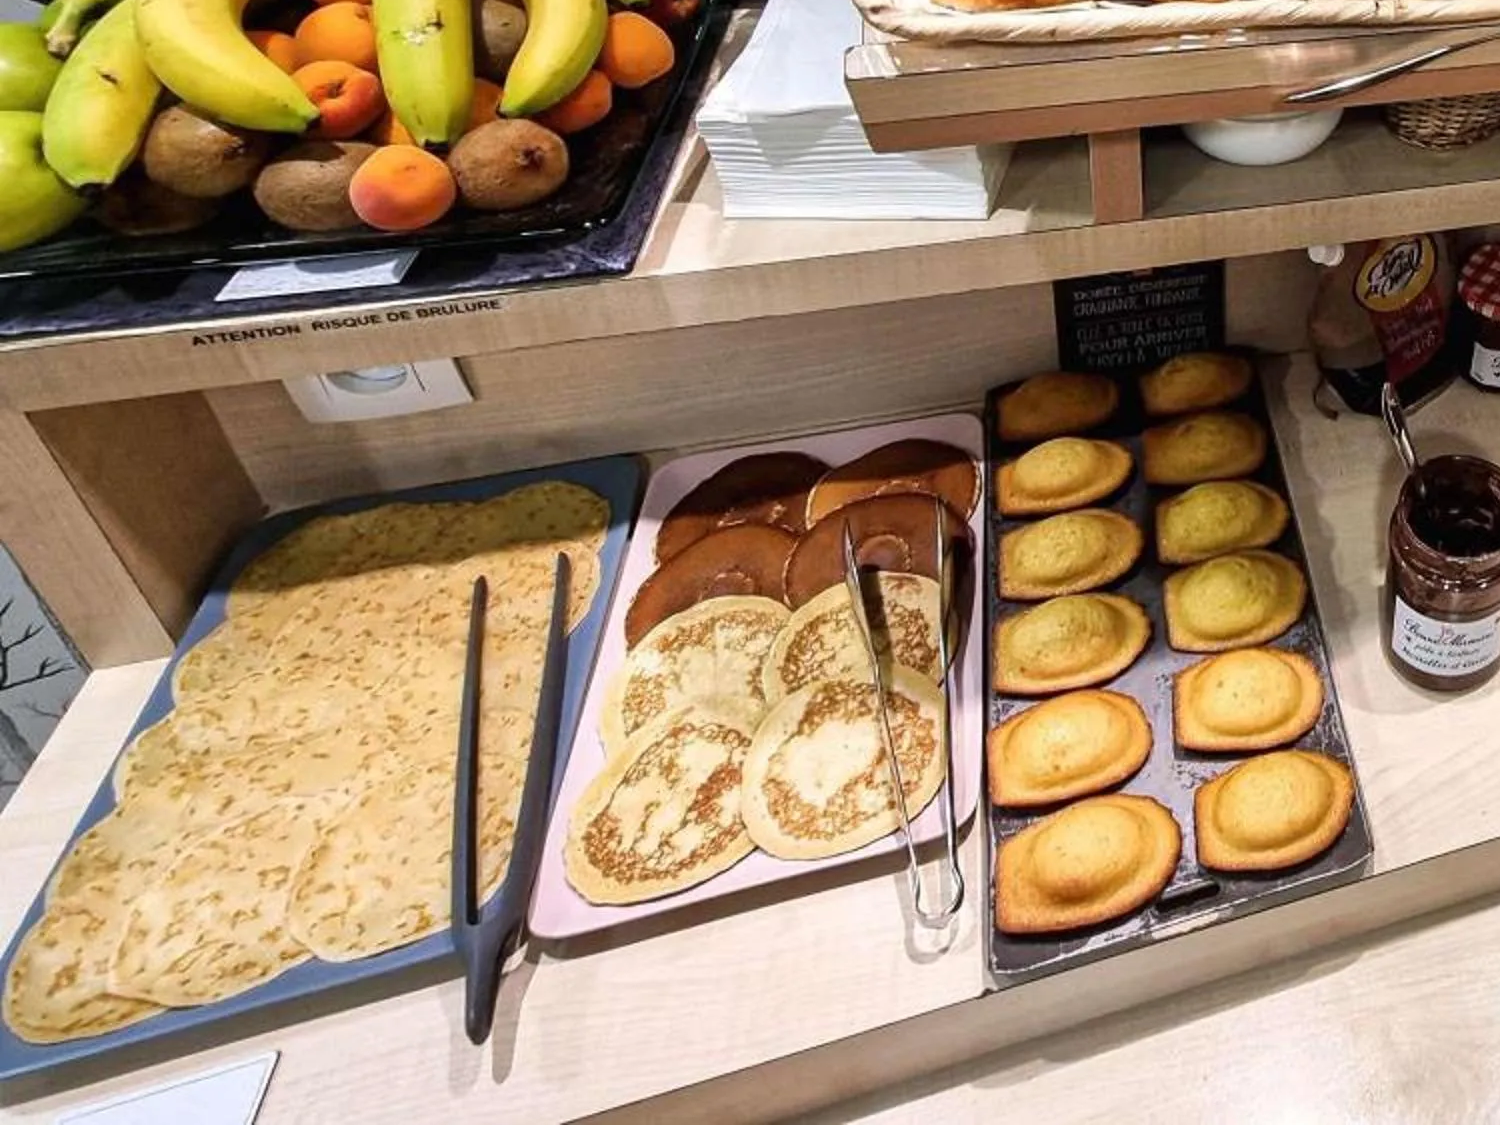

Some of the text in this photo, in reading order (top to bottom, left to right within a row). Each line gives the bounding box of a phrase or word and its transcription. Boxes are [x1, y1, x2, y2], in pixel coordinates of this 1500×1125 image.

[192, 299, 502, 346] ATTENTION RISQUE DE BRULURE
